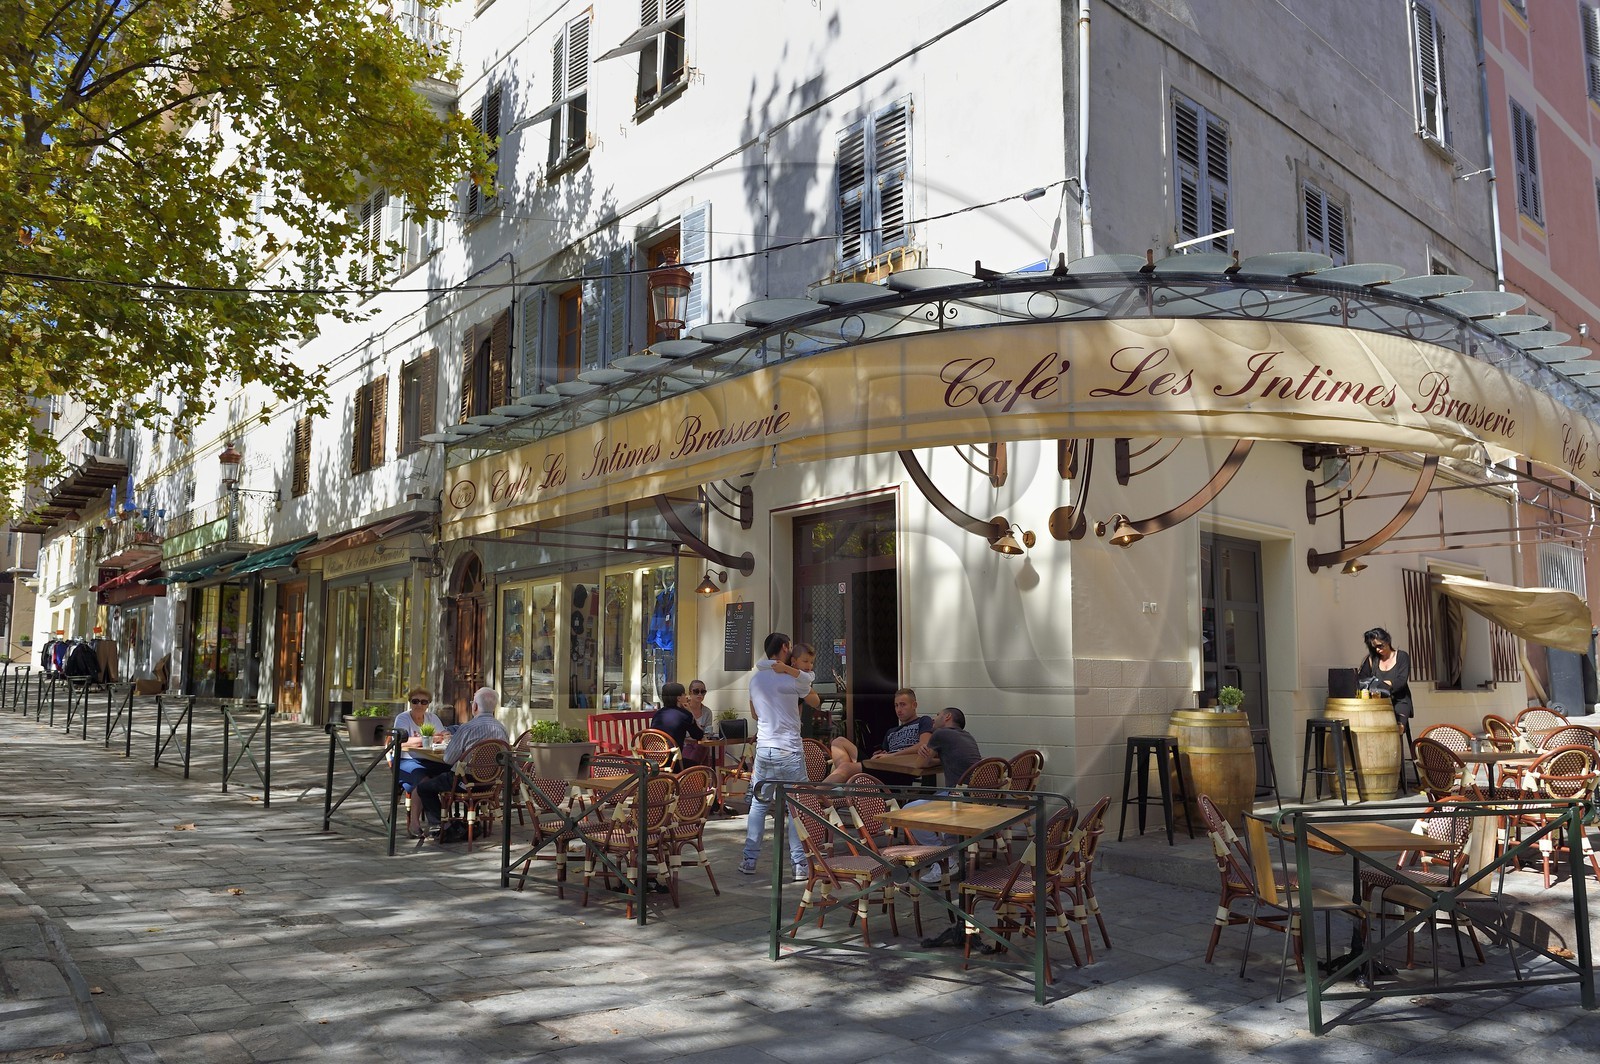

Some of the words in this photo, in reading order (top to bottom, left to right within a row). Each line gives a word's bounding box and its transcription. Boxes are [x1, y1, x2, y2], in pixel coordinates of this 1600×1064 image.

[939, 350, 1071, 413] Café
[1089, 346, 1194, 398] Les
[1213, 351, 1397, 408] Intimes
[1411, 371, 1516, 439] Brasserie
[491, 461, 533, 508] Café
[537, 452, 568, 492] Les
[582, 438, 661, 480] Intimes
[669, 404, 791, 460] Brasserie
[1561, 423, 1589, 474] Café
